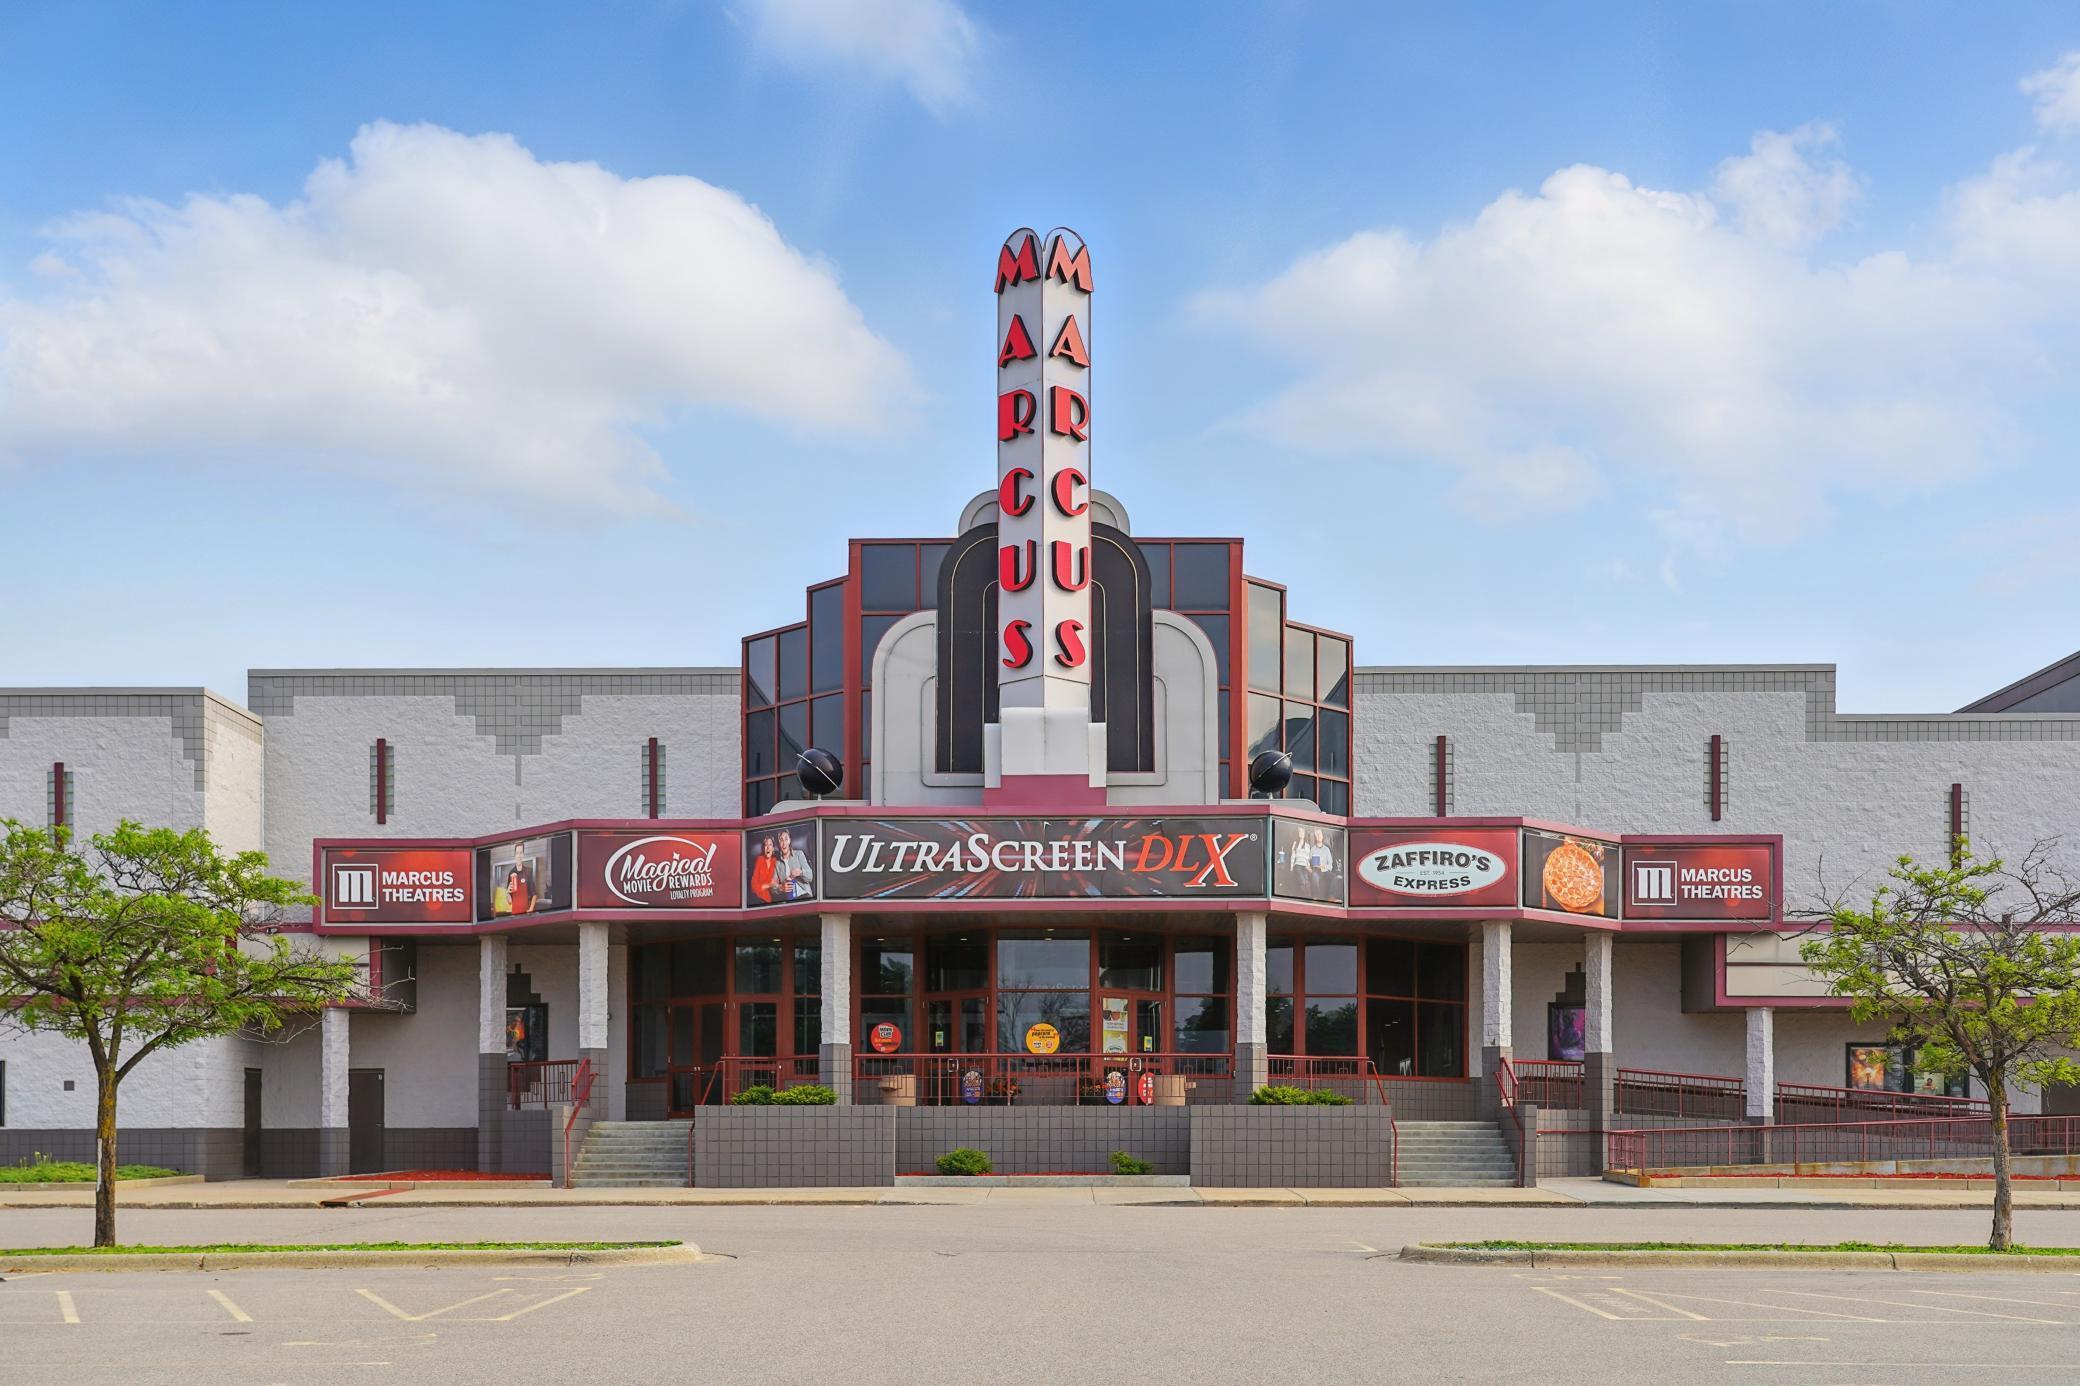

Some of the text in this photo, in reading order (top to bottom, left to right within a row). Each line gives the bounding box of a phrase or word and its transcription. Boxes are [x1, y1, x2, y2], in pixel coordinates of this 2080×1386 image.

[994, 234, 1040, 669] MARCUS
[1044, 234, 1094, 669] MARCUS
[620, 843, 717, 891] Magical
[1374, 850, 1491, 872] ZAFFIRO'S
[382, 871, 454, 886] MARCUS
[1393, 875, 1471, 890] EXPRESS
[1681, 868, 1752, 882] MARCUS
[623, 873, 713, 894] MOVIE REWARDS
[382, 888, 465, 902] THEATRES
[670, 887, 713, 900] LOYALTY PROGRAM
[1681, 885, 1763, 899] THEATRES
